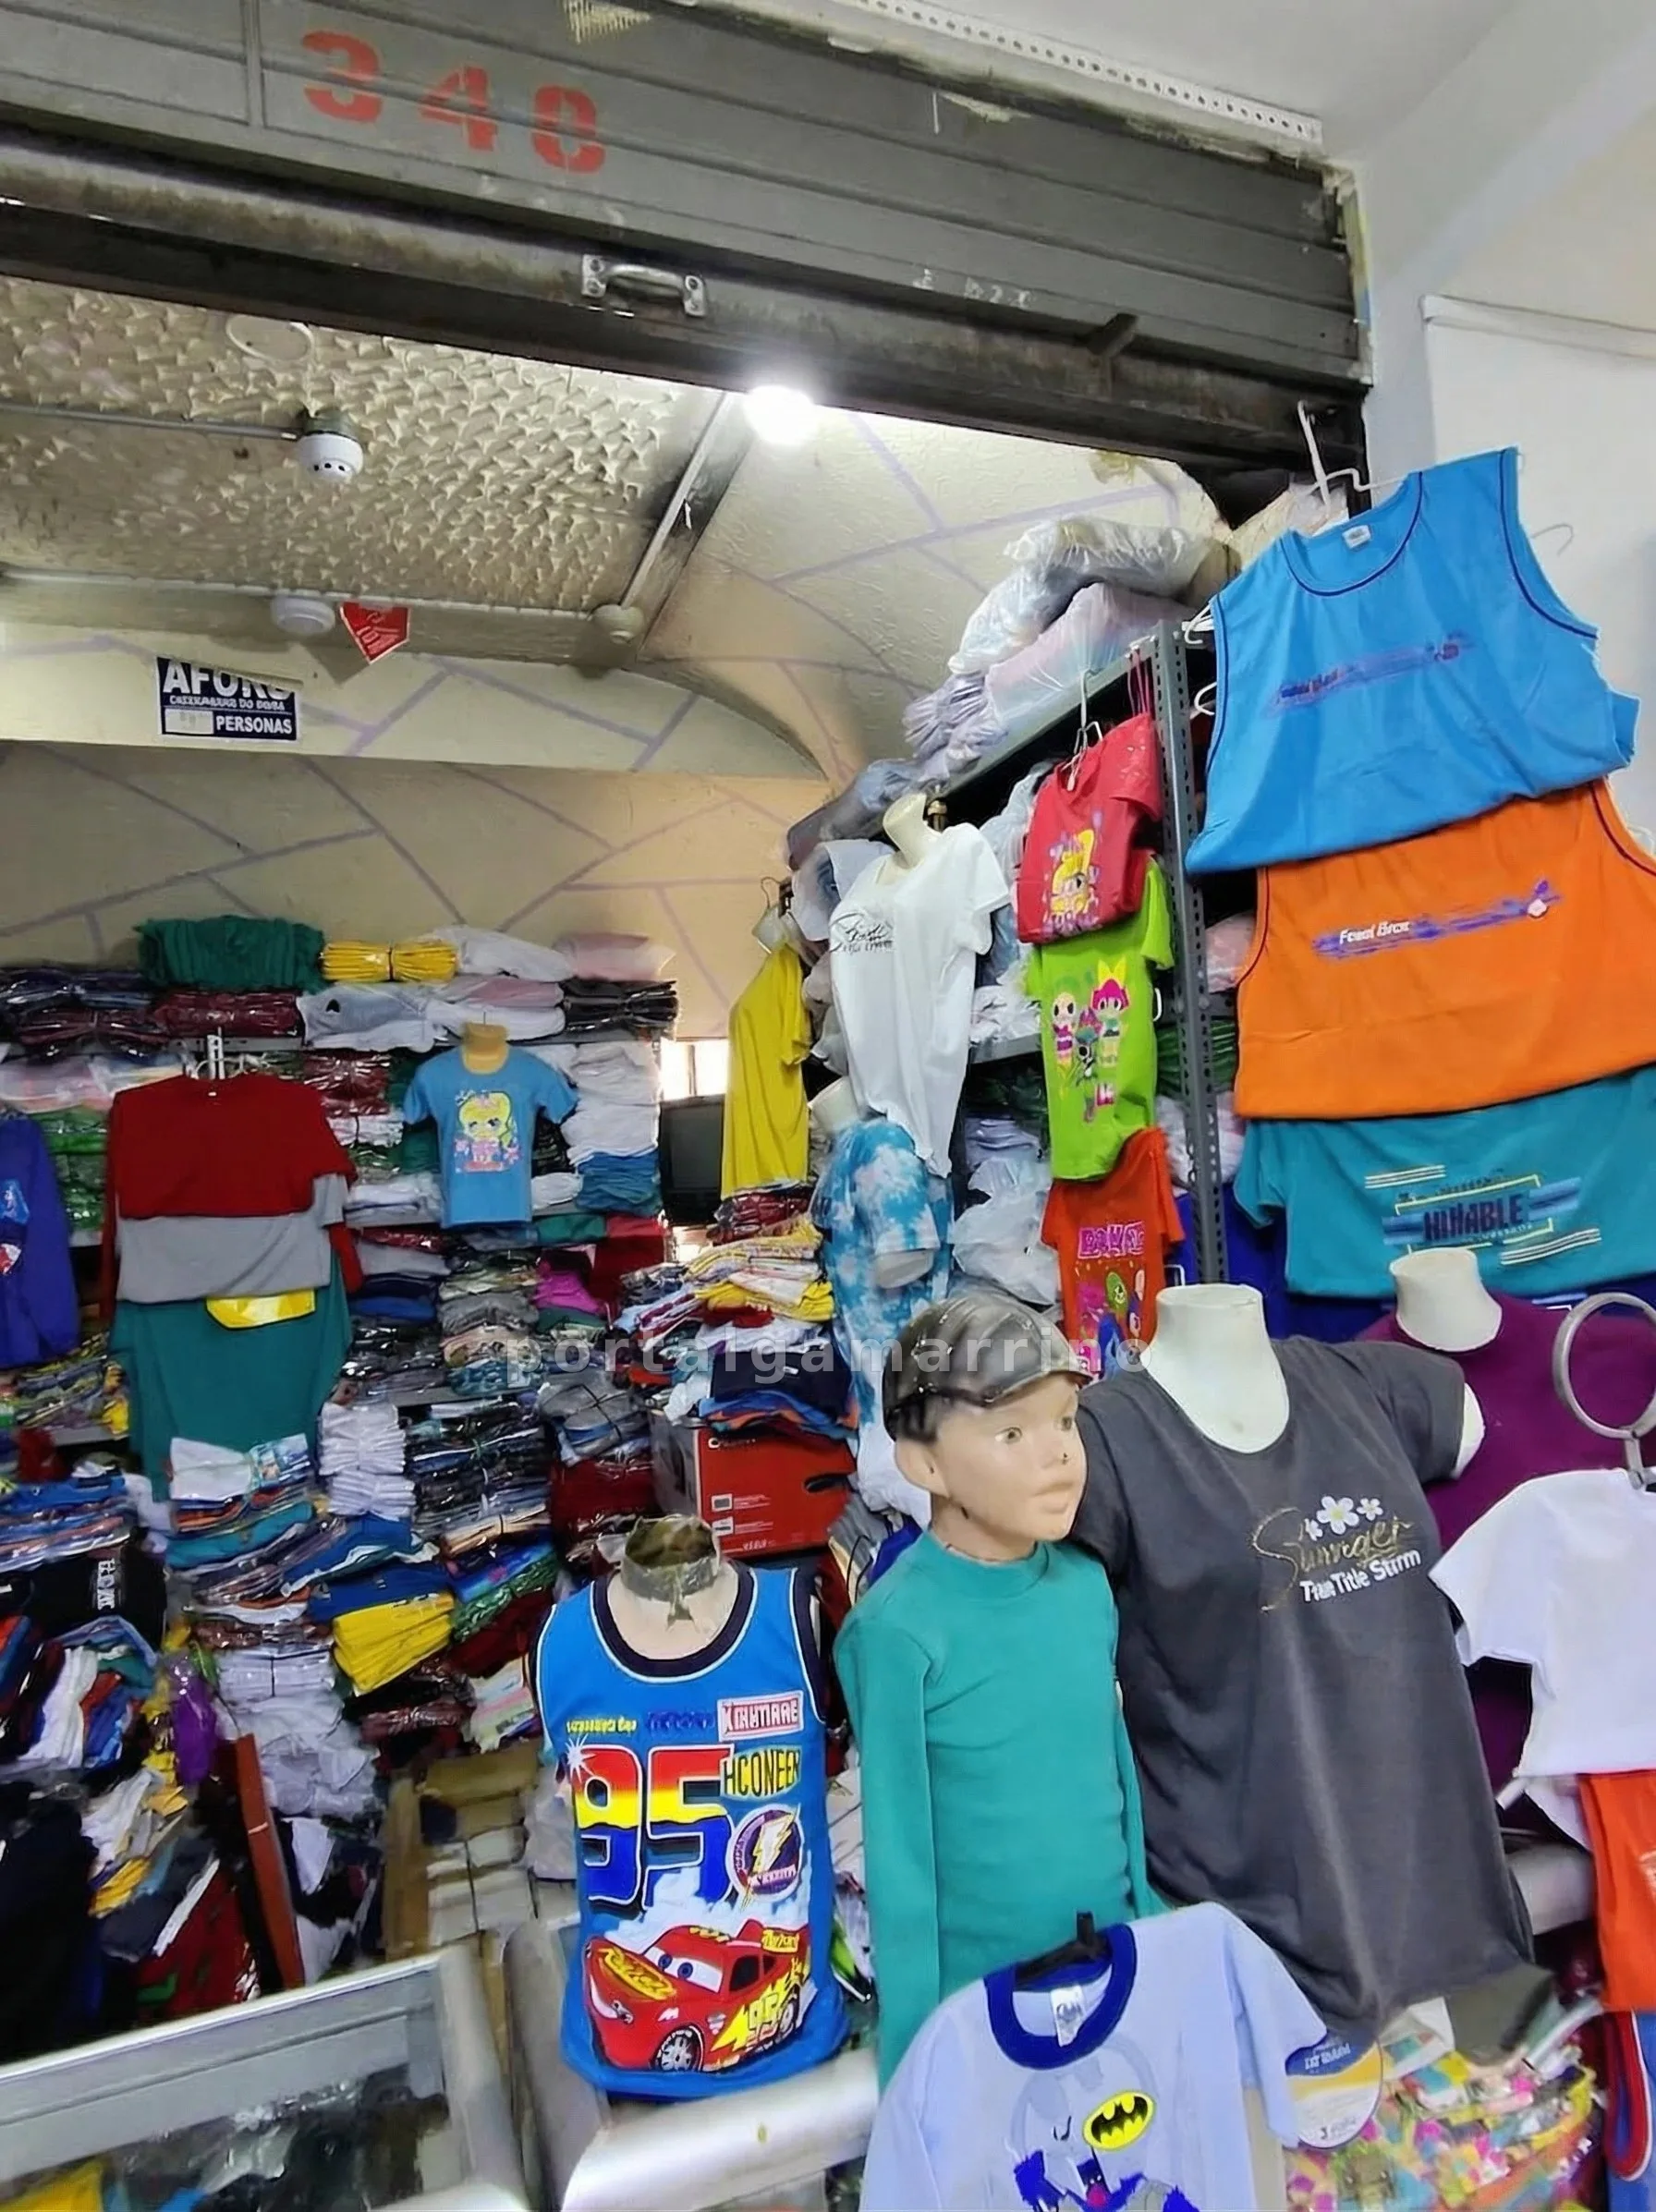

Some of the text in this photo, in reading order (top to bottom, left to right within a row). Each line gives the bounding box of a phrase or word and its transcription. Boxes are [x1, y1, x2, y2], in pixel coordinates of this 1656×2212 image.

[300, 30, 606, 174] 340
[215, 715, 293, 735] PERSONAS
[571, 1743, 736, 1909] 95
